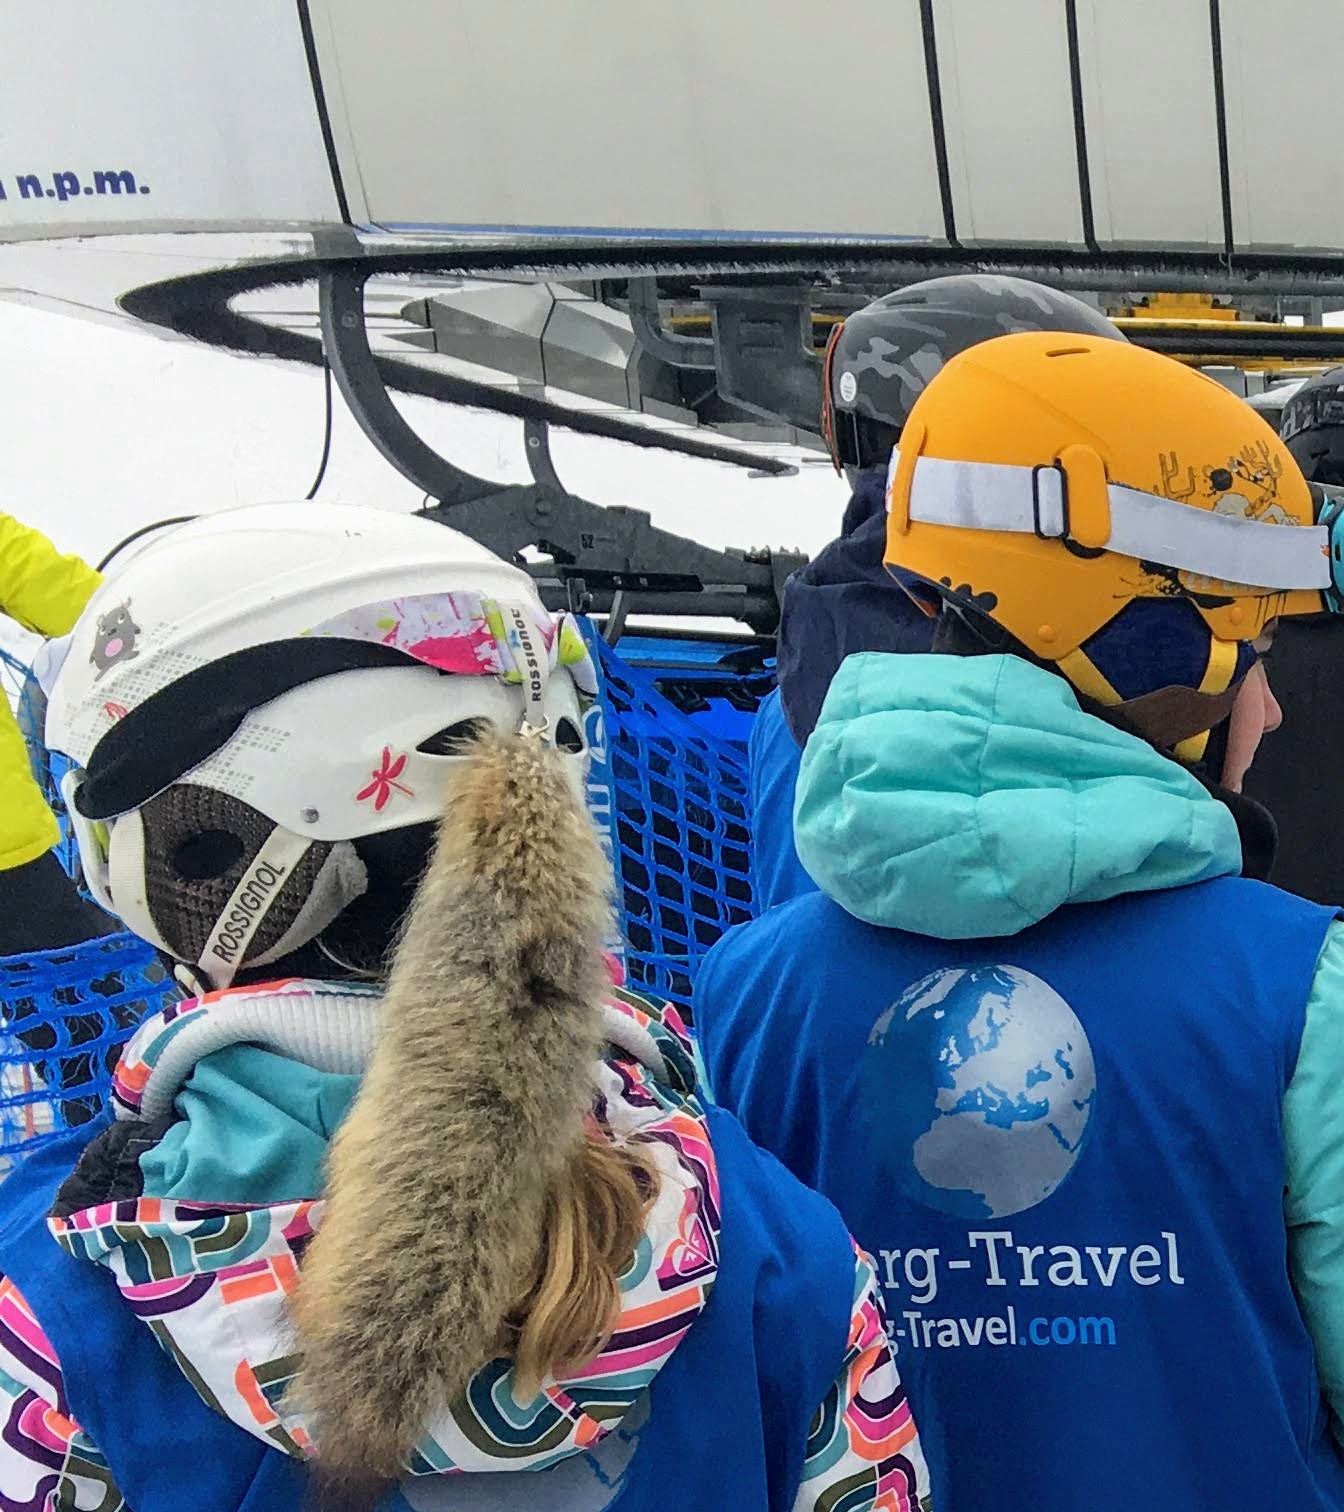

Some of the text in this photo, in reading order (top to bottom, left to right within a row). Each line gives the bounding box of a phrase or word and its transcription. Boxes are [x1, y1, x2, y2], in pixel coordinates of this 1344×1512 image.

[15, 170, 150, 201] n.p.m.
[212, 861, 285, 963] ROSSIGNOL
[884, 1306, 1116, 1355] g-Travel.com
